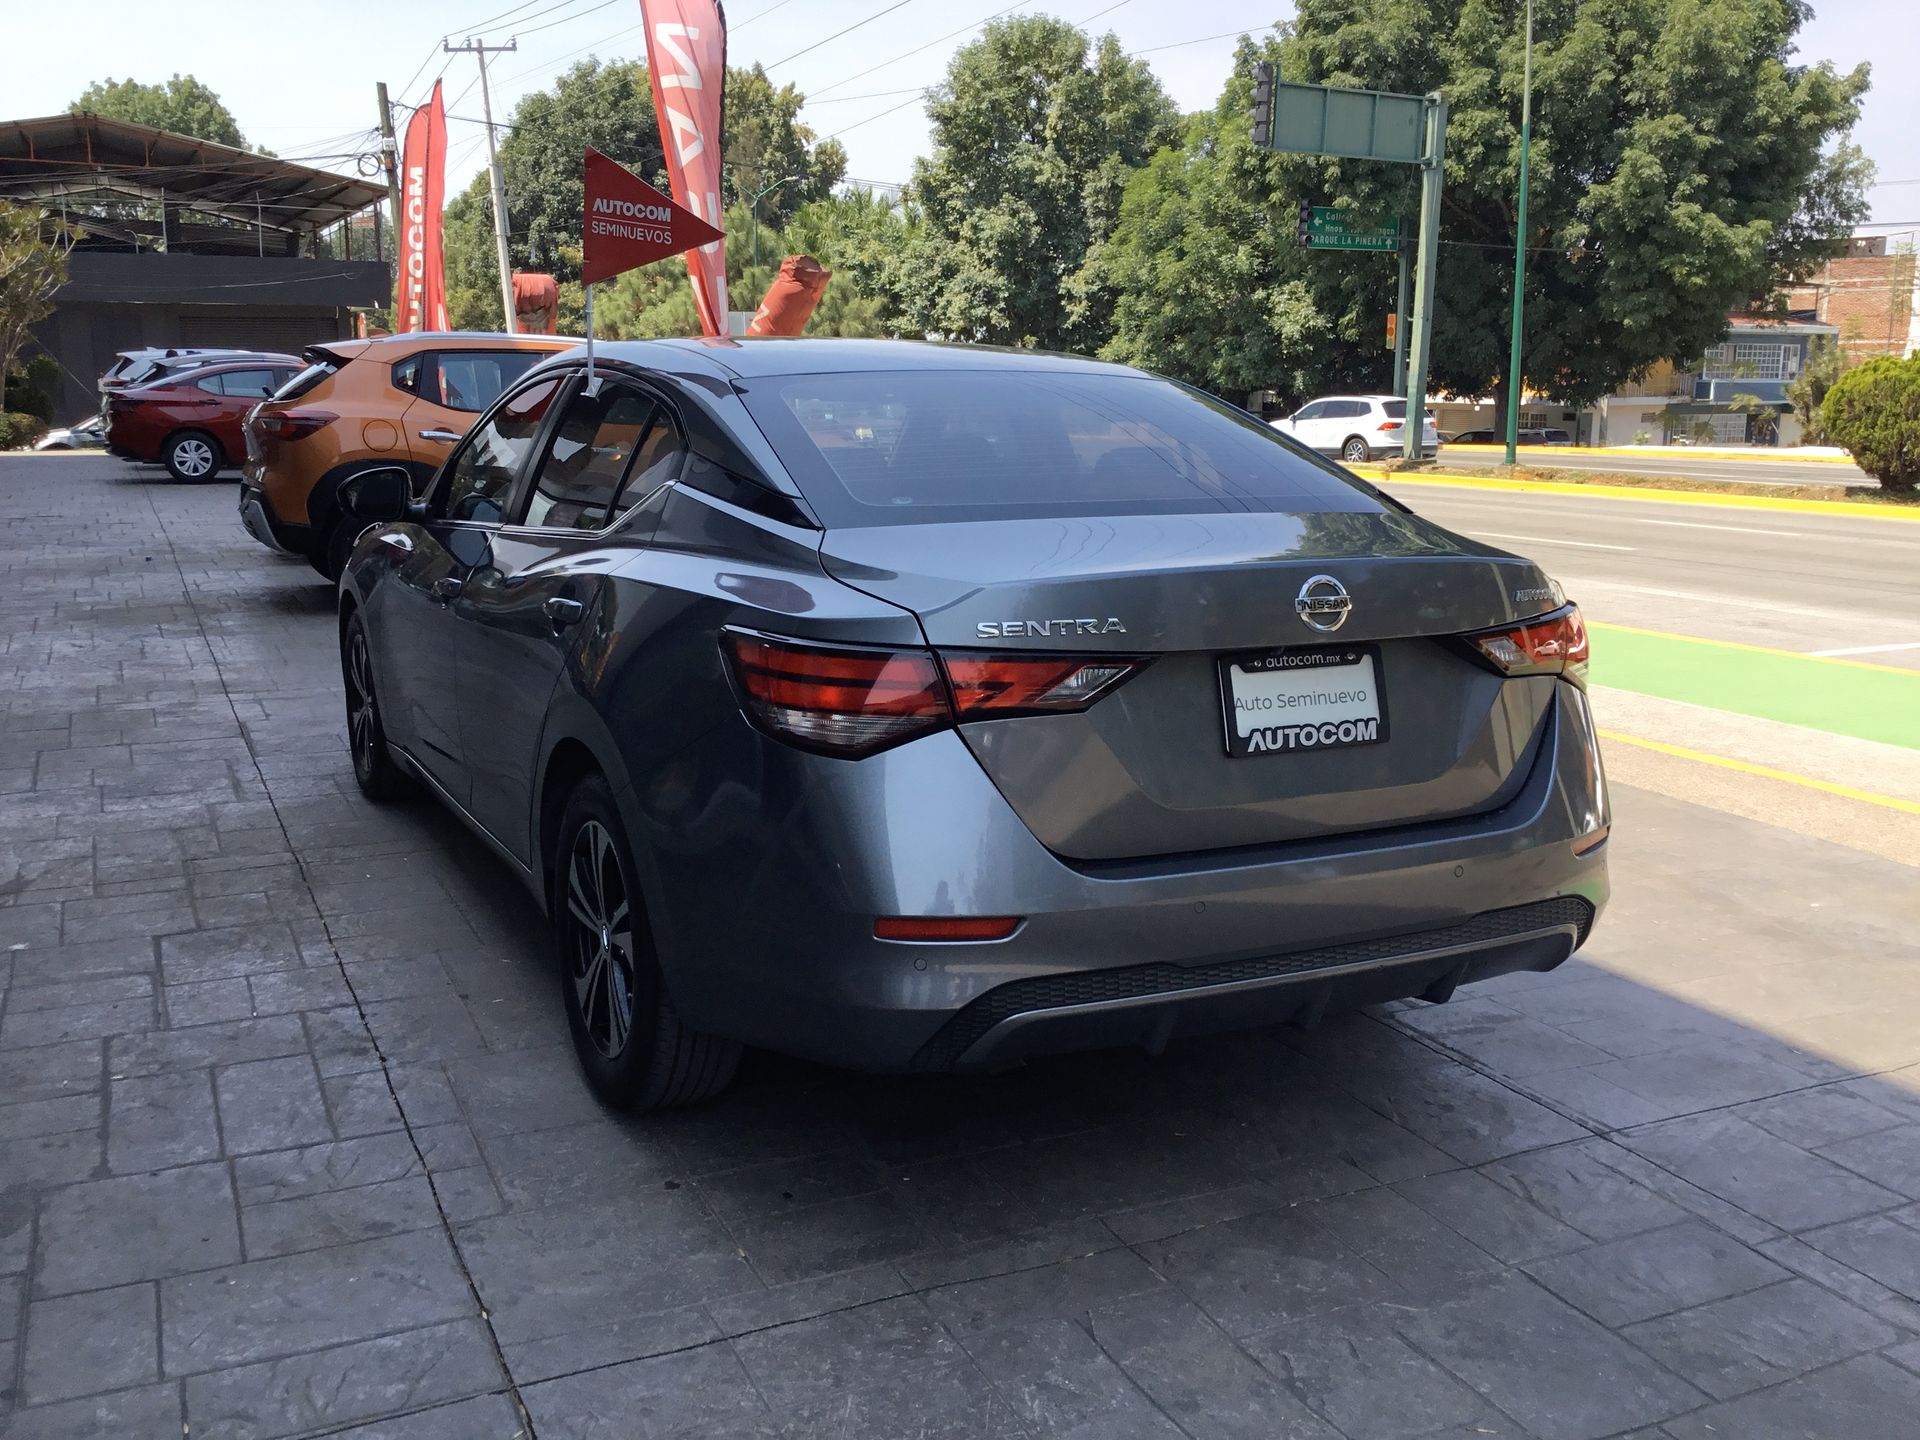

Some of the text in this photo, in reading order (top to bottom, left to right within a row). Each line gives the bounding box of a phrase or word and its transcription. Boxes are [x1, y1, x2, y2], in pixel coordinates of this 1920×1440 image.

[592, 197, 671, 222] AUTOCOM
[591, 221, 672, 244] SEMINUEVOS
[1325, 224, 1343, 233] Hnos
[408, 166, 424, 333] UTOCOM
[1311, 235, 1338, 245] PARQUE
[1341, 236, 1352, 245] LA
[1303, 599, 1347, 611] NISSAN
[976, 617, 1127, 639] SENTRA
[1265, 653, 1341, 668] autocom.mx
[1235, 690, 1368, 712] Auto Seminuevo
[1247, 720, 1378, 753] AUTOCOM
